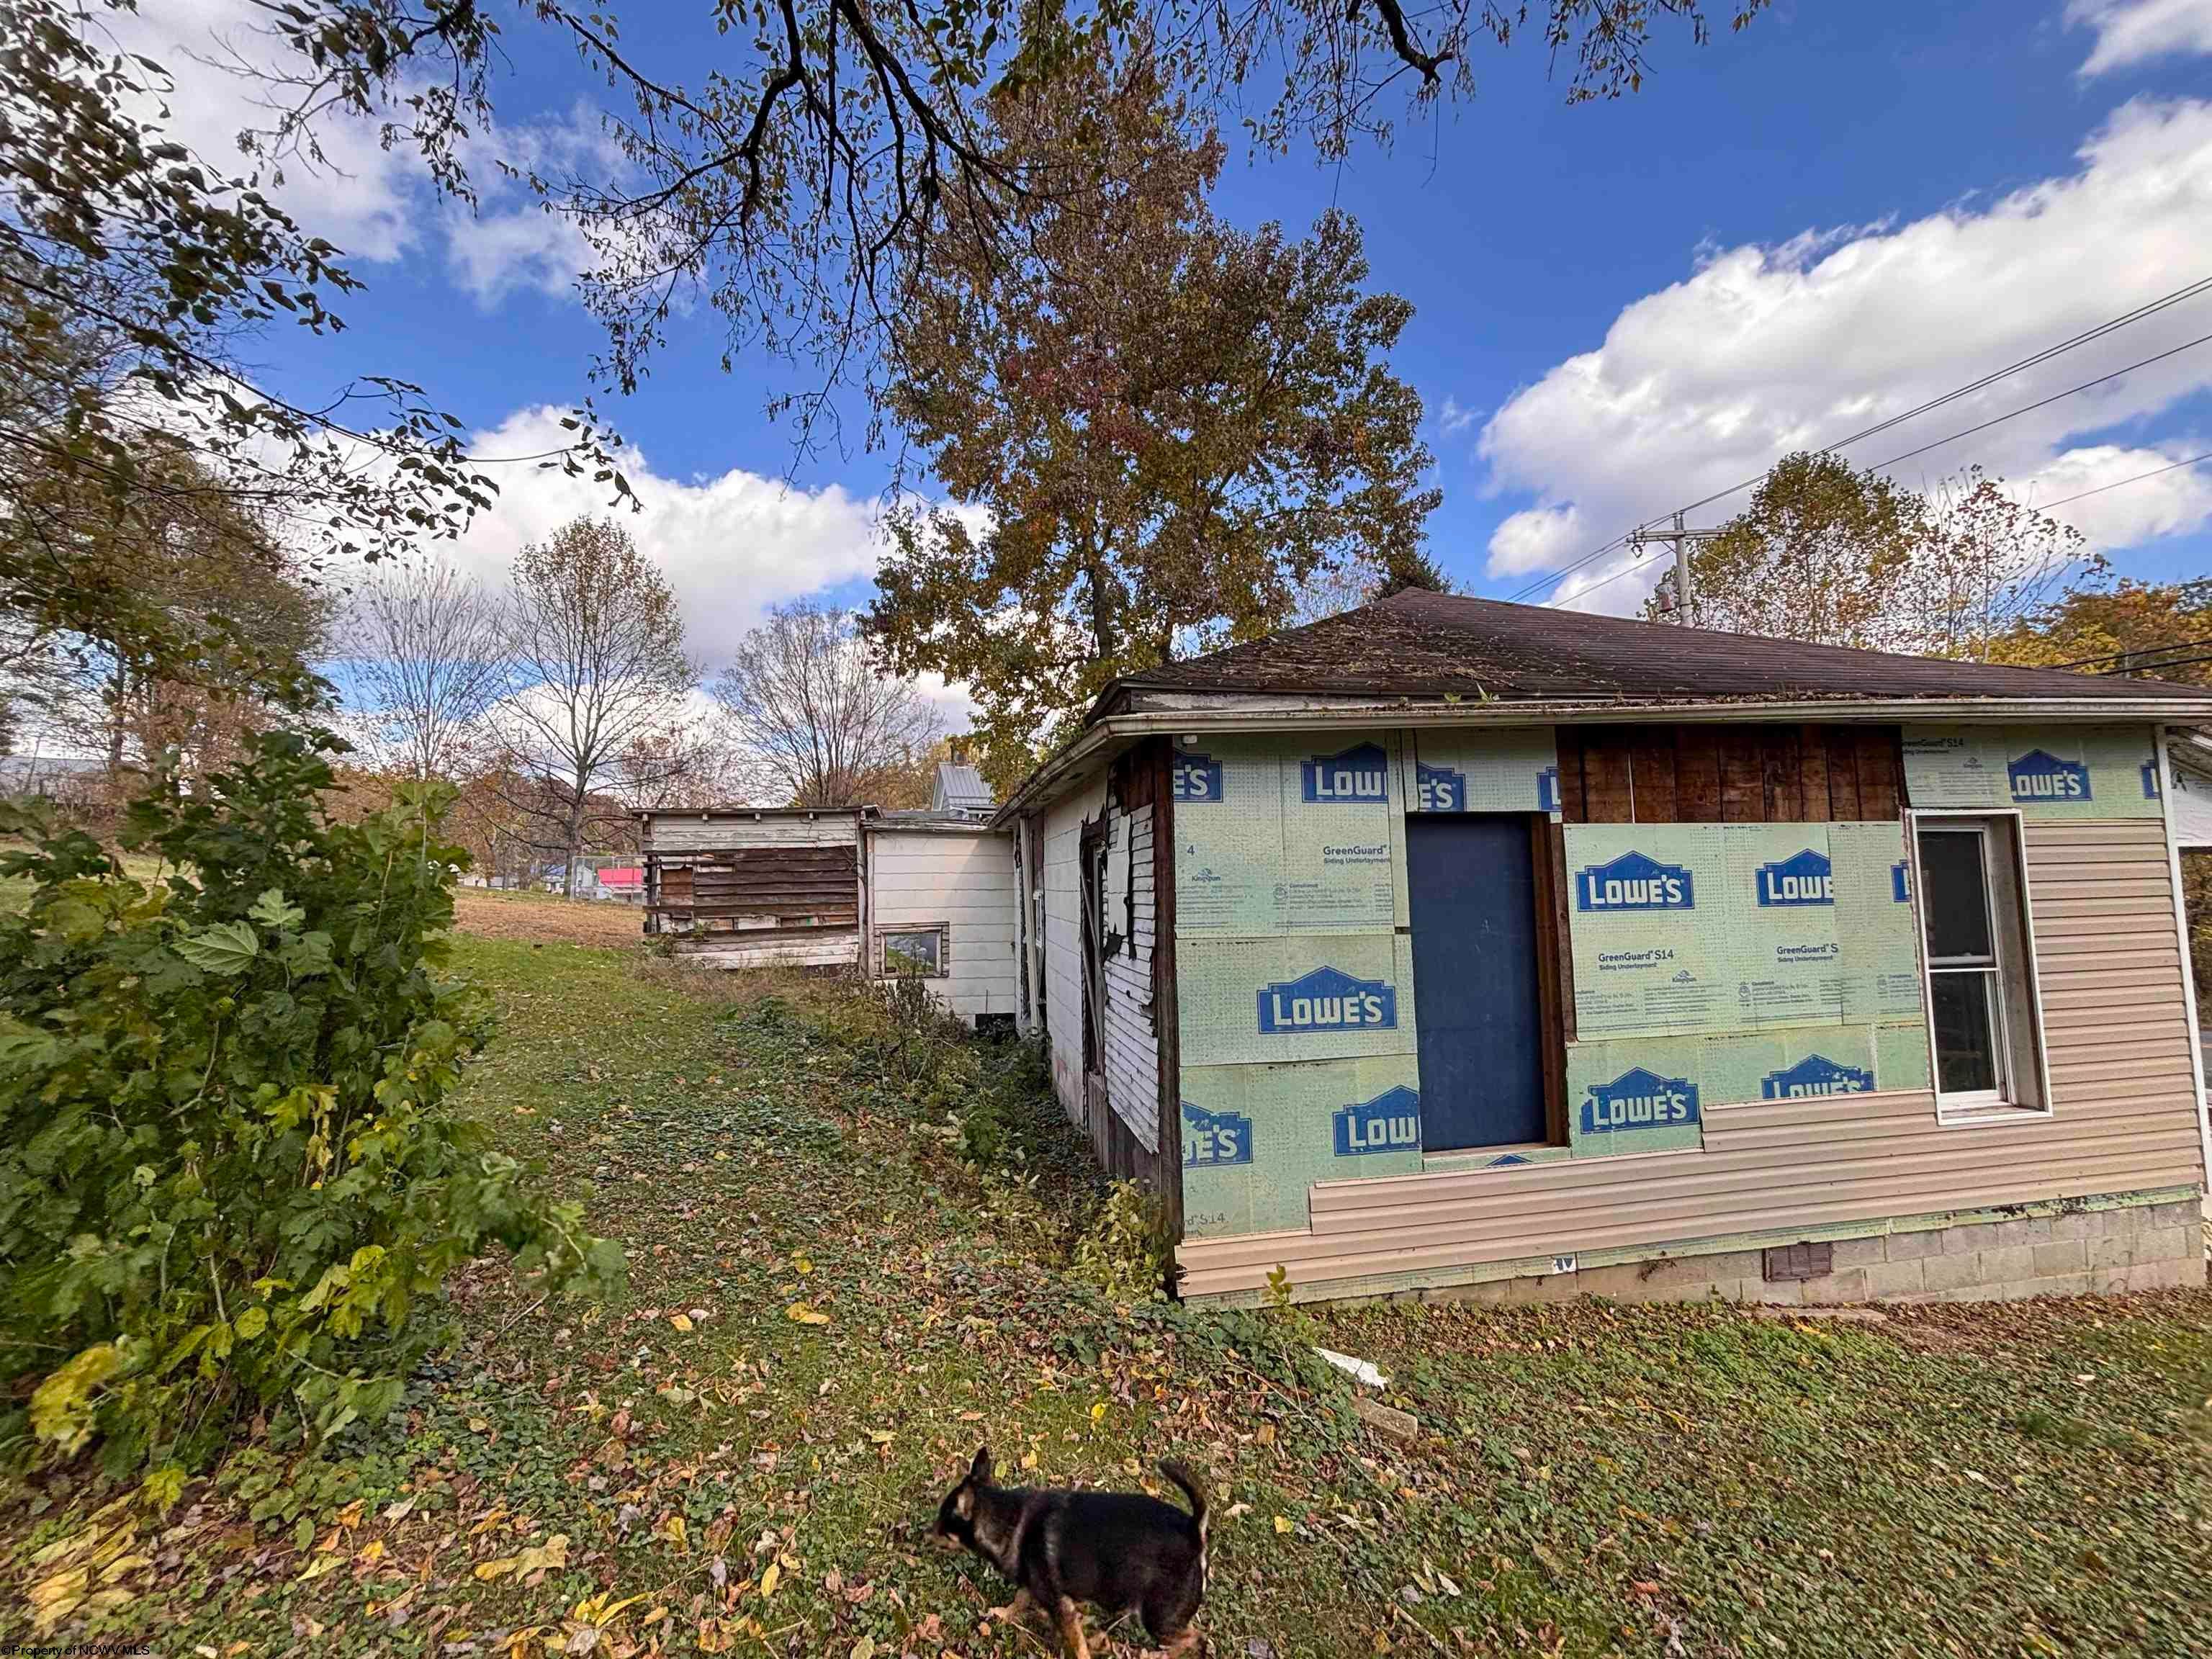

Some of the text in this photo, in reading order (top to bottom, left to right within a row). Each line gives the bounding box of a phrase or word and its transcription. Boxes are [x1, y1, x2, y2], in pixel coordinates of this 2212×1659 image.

[1315, 765, 1388, 796] LOW
[2011, 770, 2082, 796] OWE'S
[1588, 874, 1682, 904] LOWE'S
[1599, 949, 1675, 963] GreenGuard S14
[1777, 944, 1827, 955] GreenGuard
[1272, 991, 1382, 1026] LOWE'S
[1592, 1090, 1687, 1125] LOWE'S
